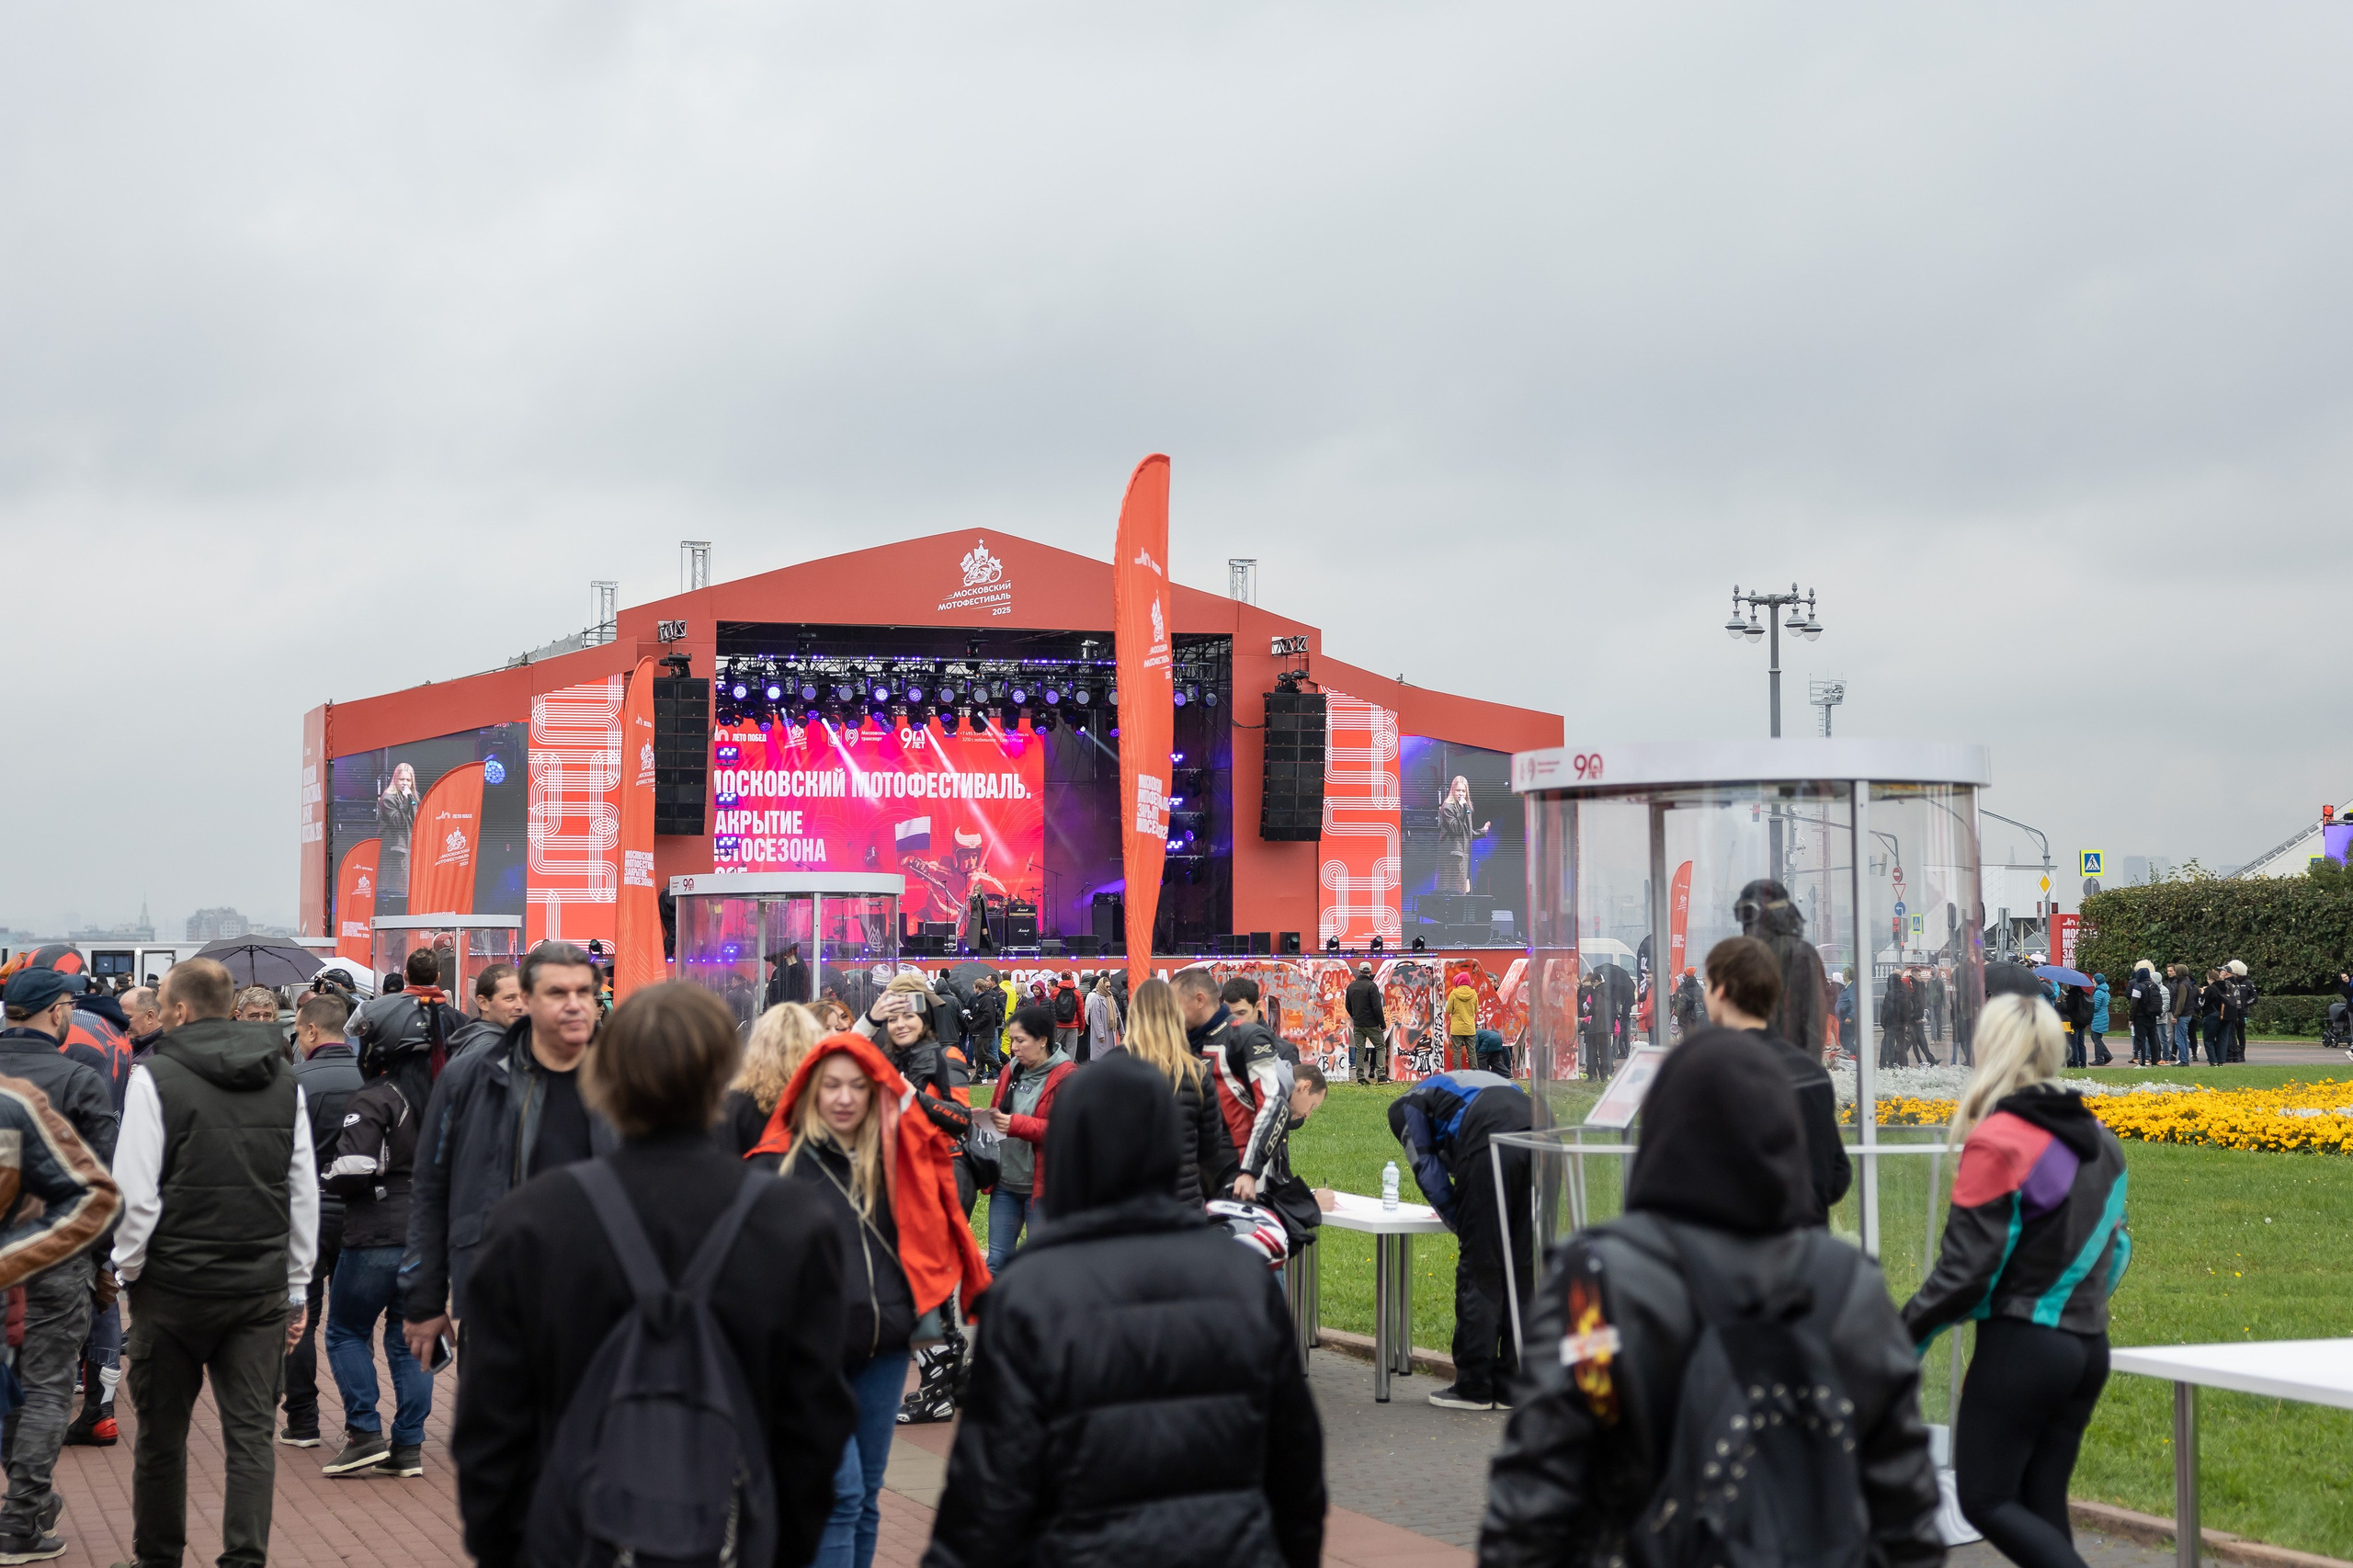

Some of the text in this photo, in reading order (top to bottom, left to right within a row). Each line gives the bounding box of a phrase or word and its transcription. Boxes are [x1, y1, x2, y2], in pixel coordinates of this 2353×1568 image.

[953, 580, 1011, 598] МОСКОВСКИЙ
[938, 593, 1011, 611] МОТОФЕСТИВАЛЬ
[992, 607, 1011, 616] 2025
[732, 733, 767, 742] ЛЕТО ПОБЕД
[912, 741, 926, 749] ЛЕТ
[851, 771, 1031, 800] МОТОФЕСТИВАЛЬ.
[714, 810, 803, 835] АКРЫТИЕ
[714, 837, 827, 862] ТОСЕЗОНА
